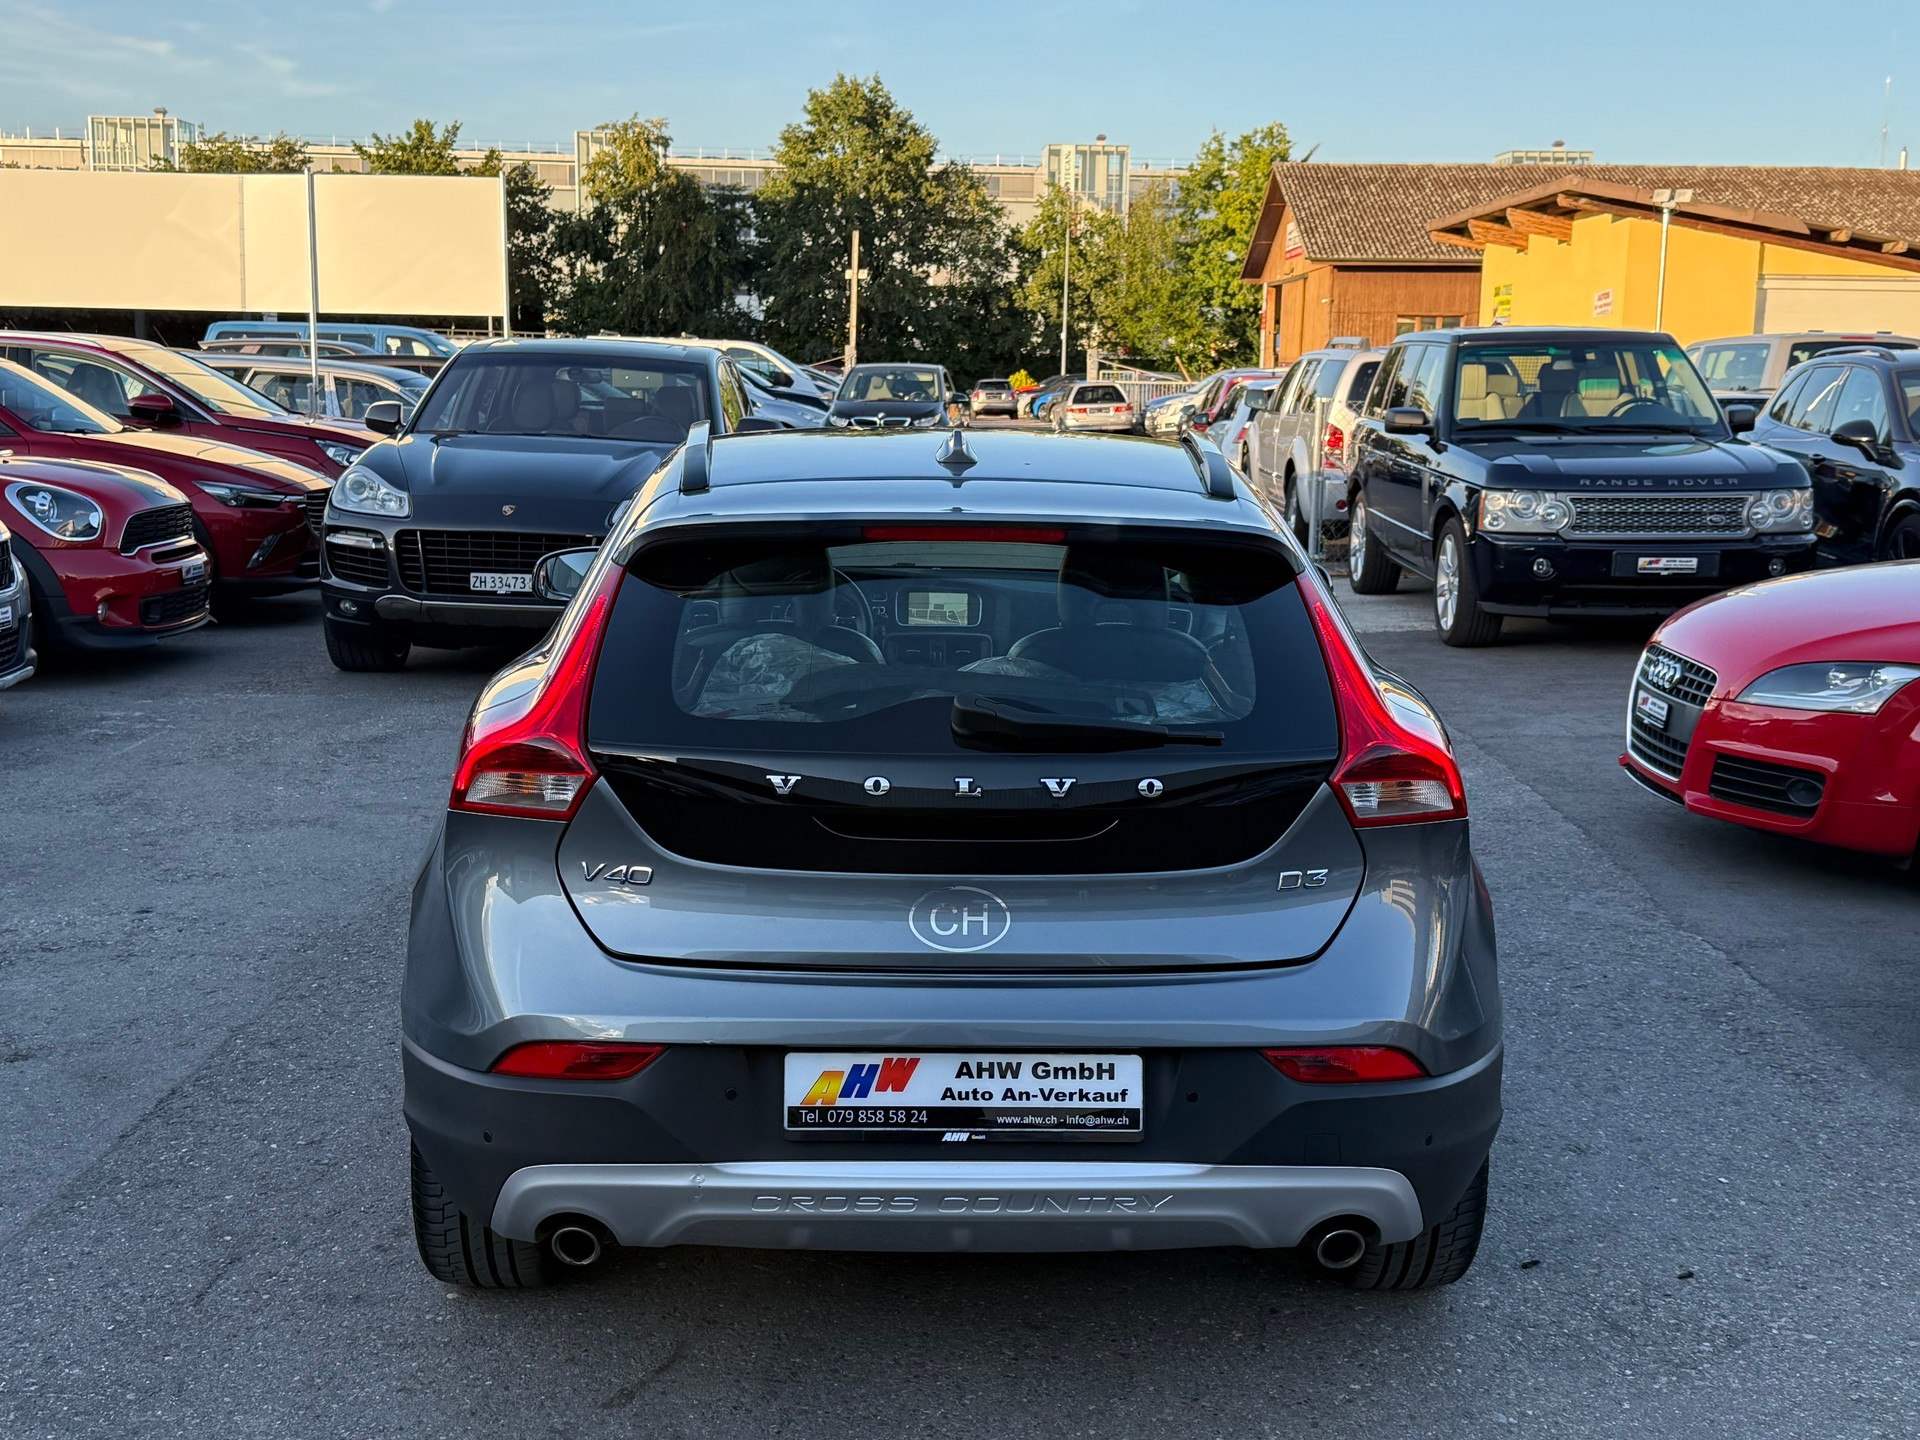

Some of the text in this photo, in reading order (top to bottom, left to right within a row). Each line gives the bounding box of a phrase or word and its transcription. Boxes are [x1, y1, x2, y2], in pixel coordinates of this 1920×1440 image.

[1579, 477, 1739, 486] RANGE ROVER
[472, 575, 487, 589] ZH
[765, 774, 1164, 798] VOLVO
[581, 861, 654, 885] V40
[1276, 868, 1329, 891] D3
[929, 902, 989, 936] CH
[954, 1061, 1115, 1081] AHW GmbH
[800, 1057, 921, 1105] AHW
[940, 1086, 1129, 1103] Auto An-Verkauf
[799, 1109, 928, 1124] Tel. 079 858 58 24
[996, 1115, 1058, 1125] www.ahw.ch
[1066, 1114, 1130, 1126] info@ahw.ch
[941, 1132, 971, 1142] AHW
[751, 1195, 1174, 1214] CROSS COUNTRY
